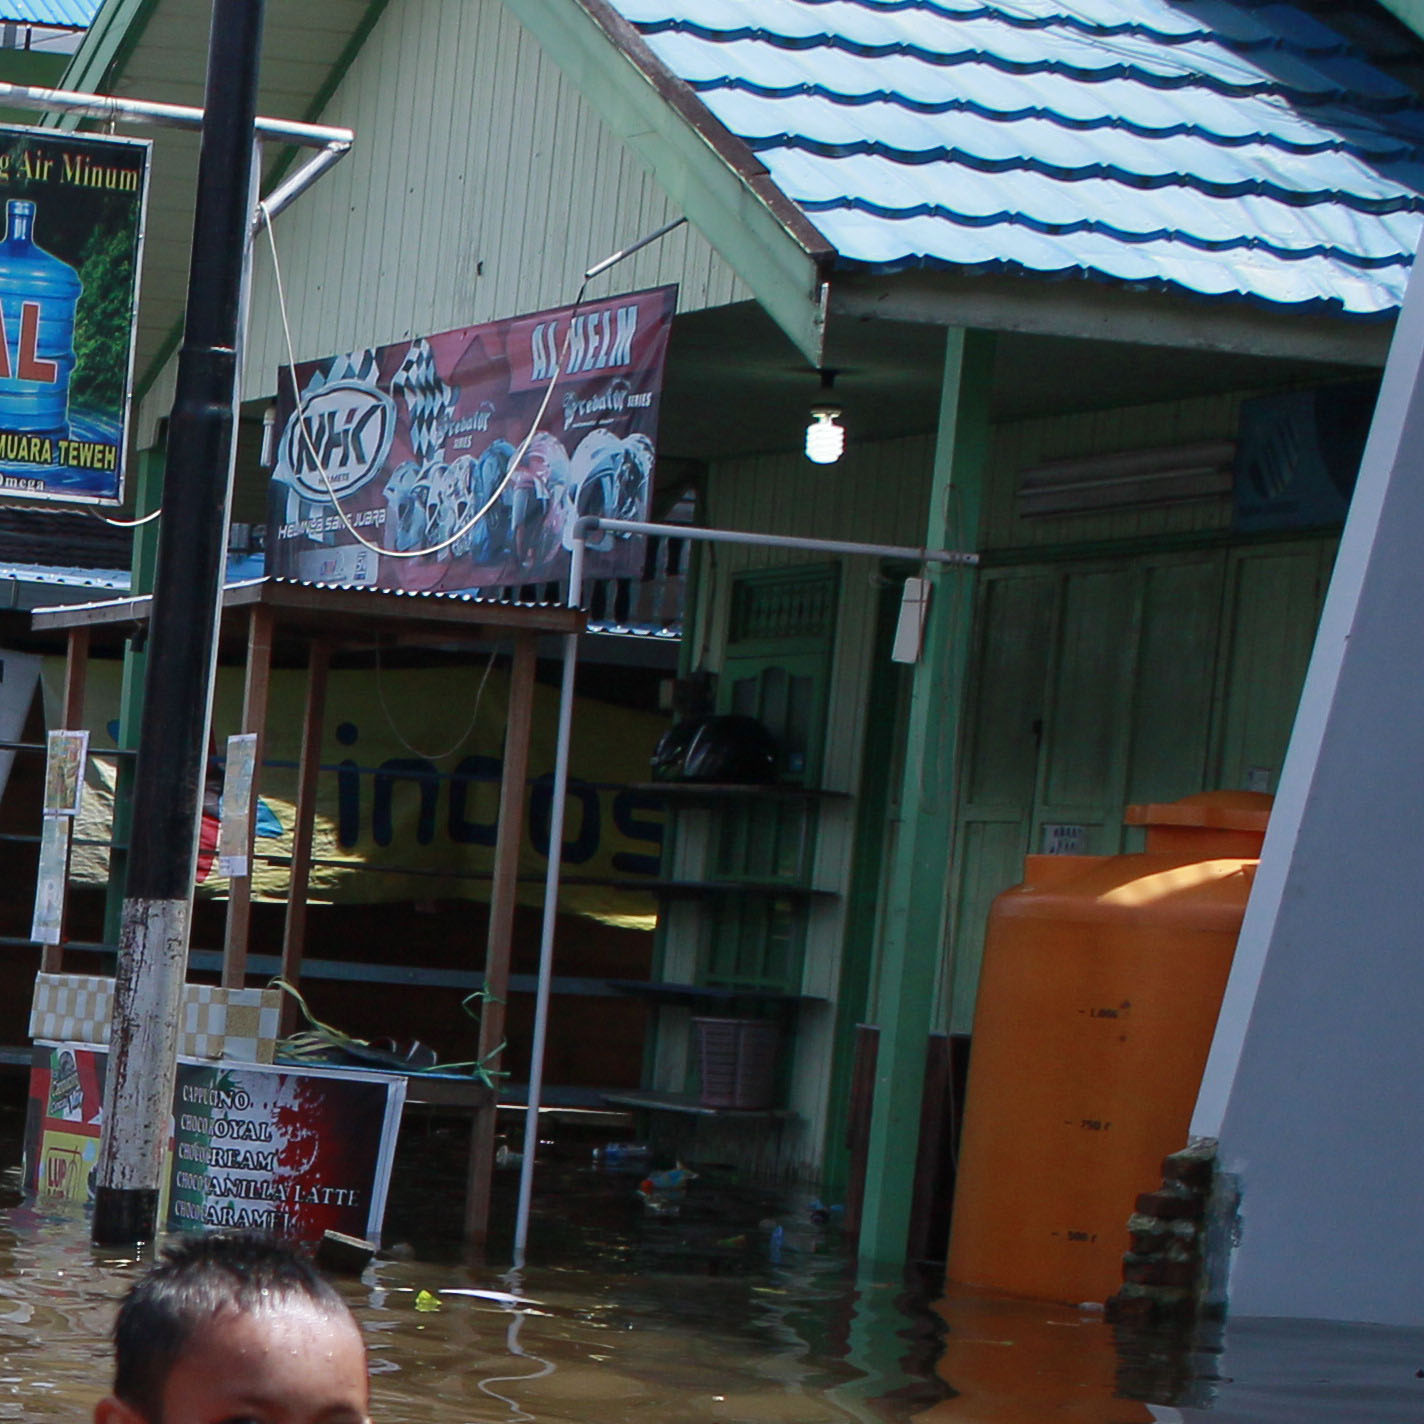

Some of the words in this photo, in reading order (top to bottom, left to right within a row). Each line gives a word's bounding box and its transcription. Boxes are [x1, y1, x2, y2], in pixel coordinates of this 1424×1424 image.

[16, 150, 54, 181] Air
[60, 154, 139, 191] Minum
[531, 321, 560, 381] AL
[565, 304, 639, 375] HELM
[58, 440, 117, 470] TEWEH
[295, 402, 386, 475] NHK
[295, 1184, 361, 1208] LATTE
